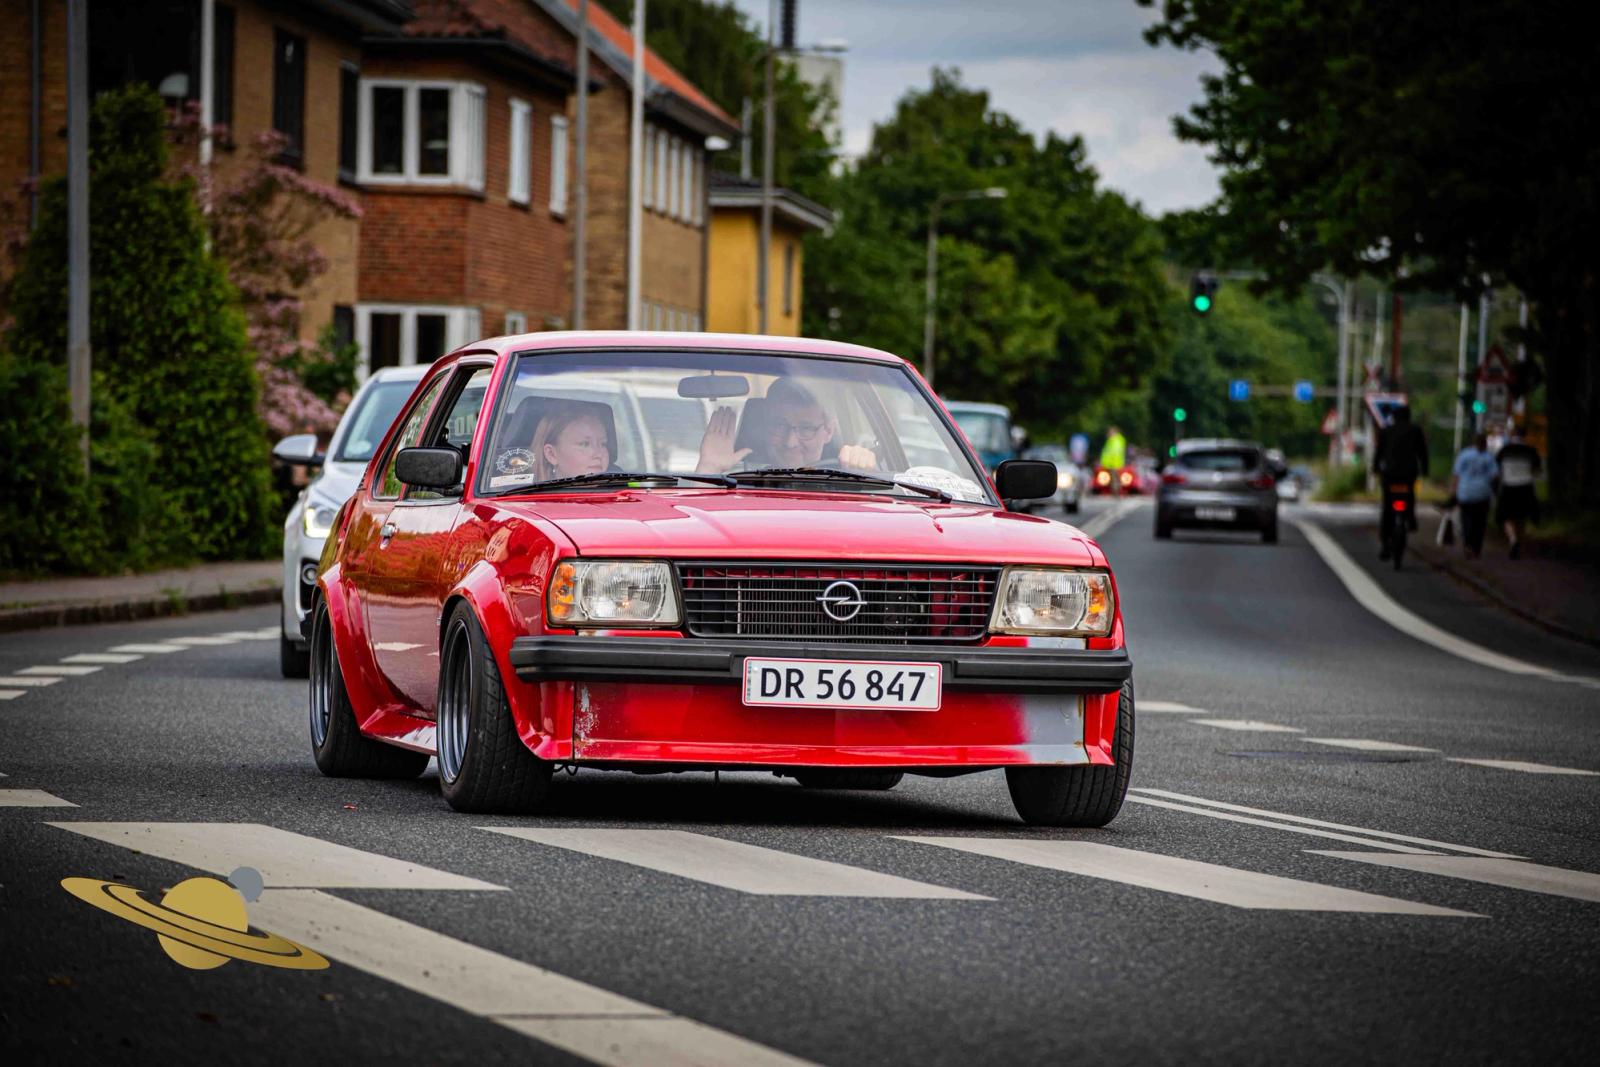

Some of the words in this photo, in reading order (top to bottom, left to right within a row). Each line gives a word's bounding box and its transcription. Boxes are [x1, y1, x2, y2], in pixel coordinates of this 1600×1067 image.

[761, 668, 804, 699] DR
[816, 669, 856, 701] 56
[865, 670, 926, 702] 847
